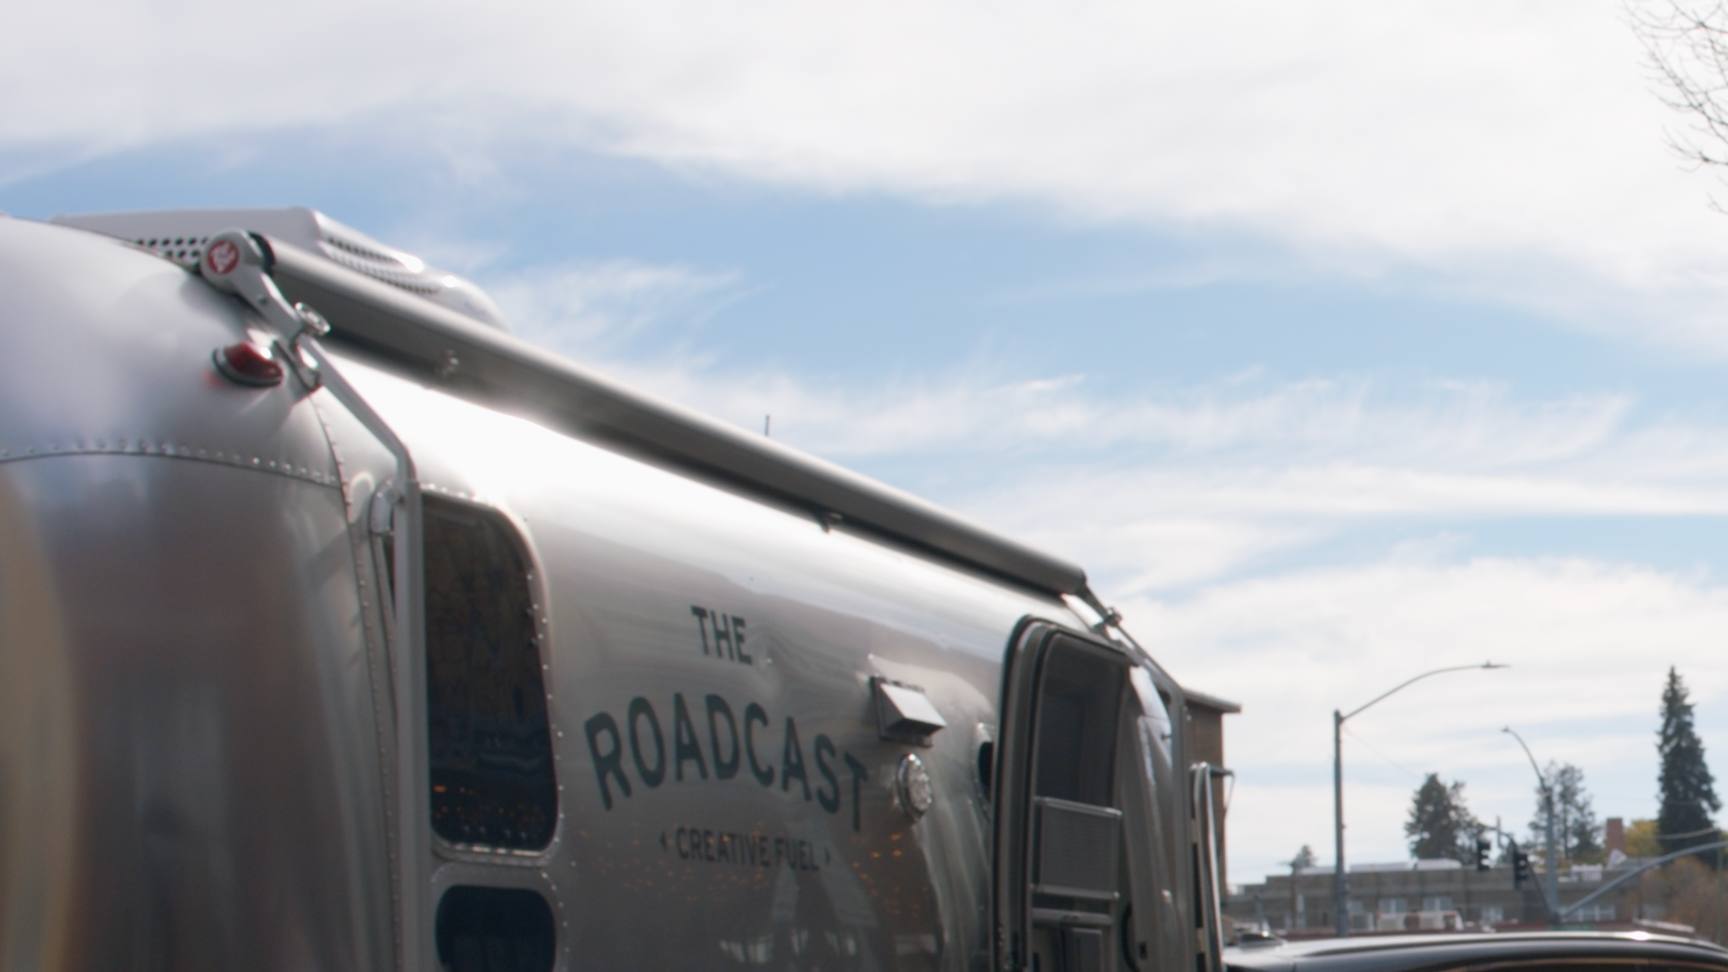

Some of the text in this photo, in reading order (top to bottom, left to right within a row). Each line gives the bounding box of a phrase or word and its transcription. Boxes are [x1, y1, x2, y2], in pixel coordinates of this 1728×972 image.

[690, 605, 752, 665] THE
[584, 693, 868, 832] ROADCAST
[677, 828, 819, 871] CREATIVE FUEL
